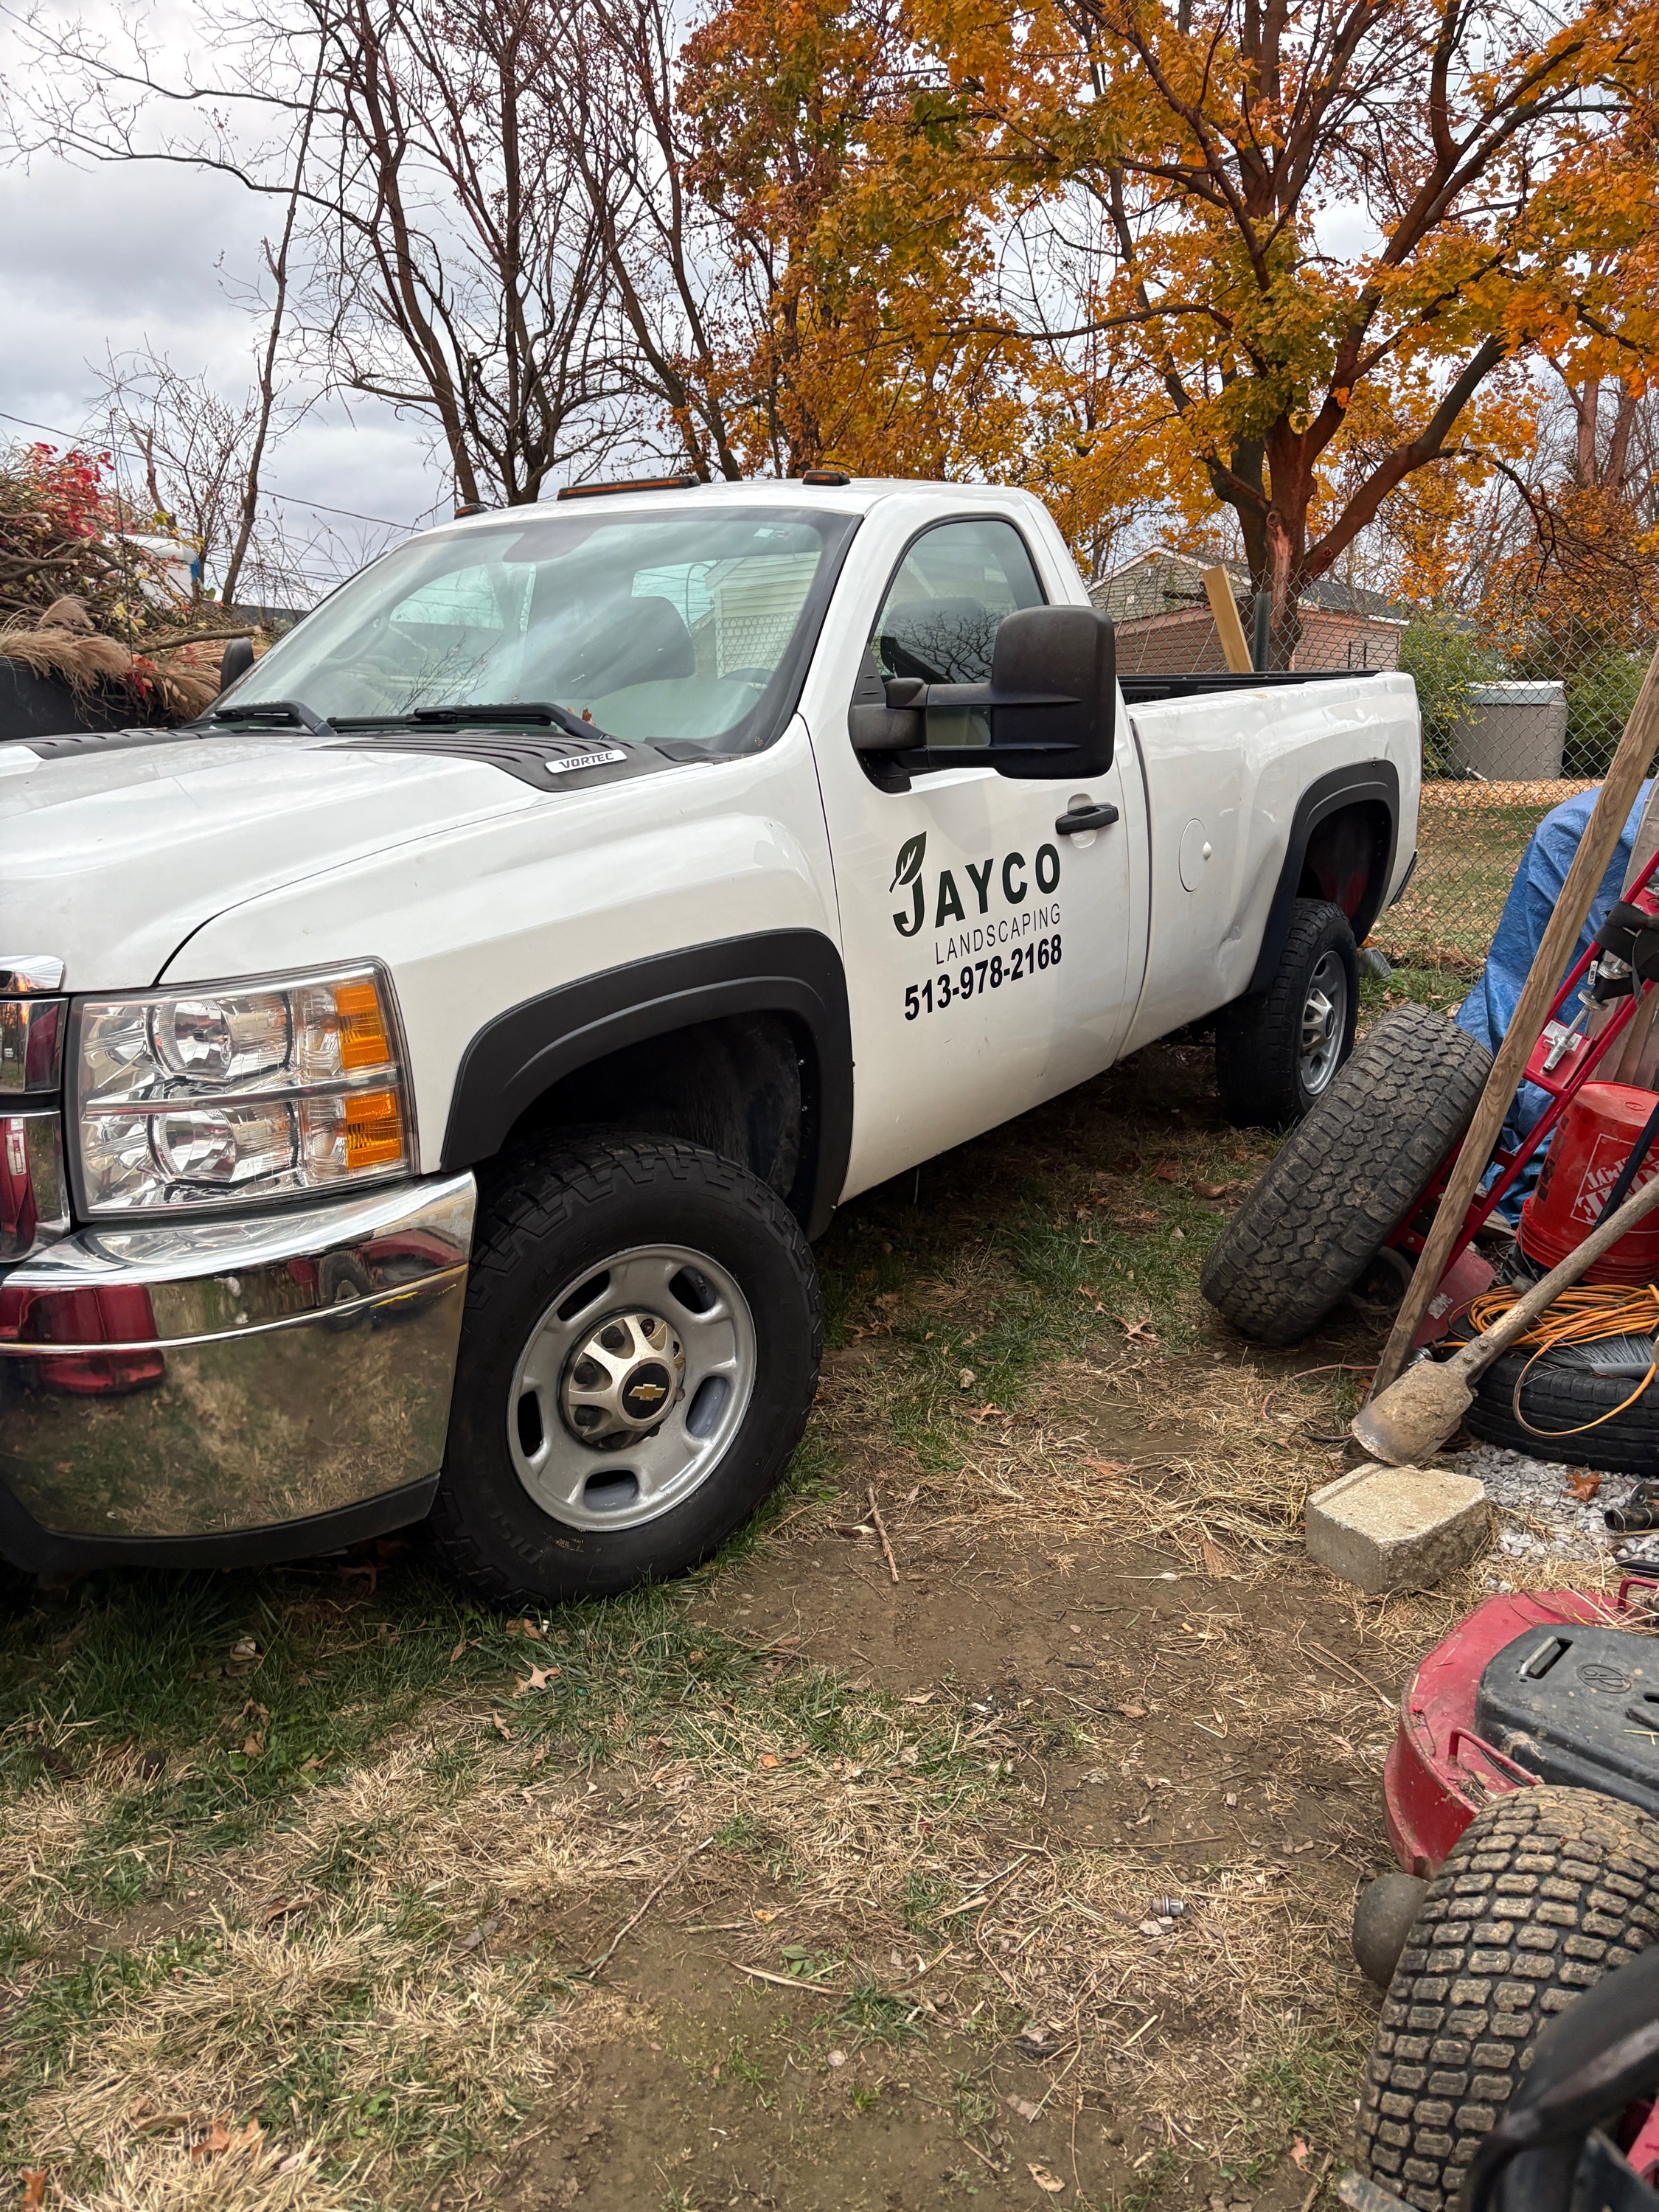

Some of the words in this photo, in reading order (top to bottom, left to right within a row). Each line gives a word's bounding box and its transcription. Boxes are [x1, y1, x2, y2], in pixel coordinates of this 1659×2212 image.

[558, 752, 614, 769] VORTEC
[892, 843, 1060, 937] JAYCO
[935, 903, 1060, 965] LANDSCAPING
[904, 933, 1062, 1021] 513-978-2168
